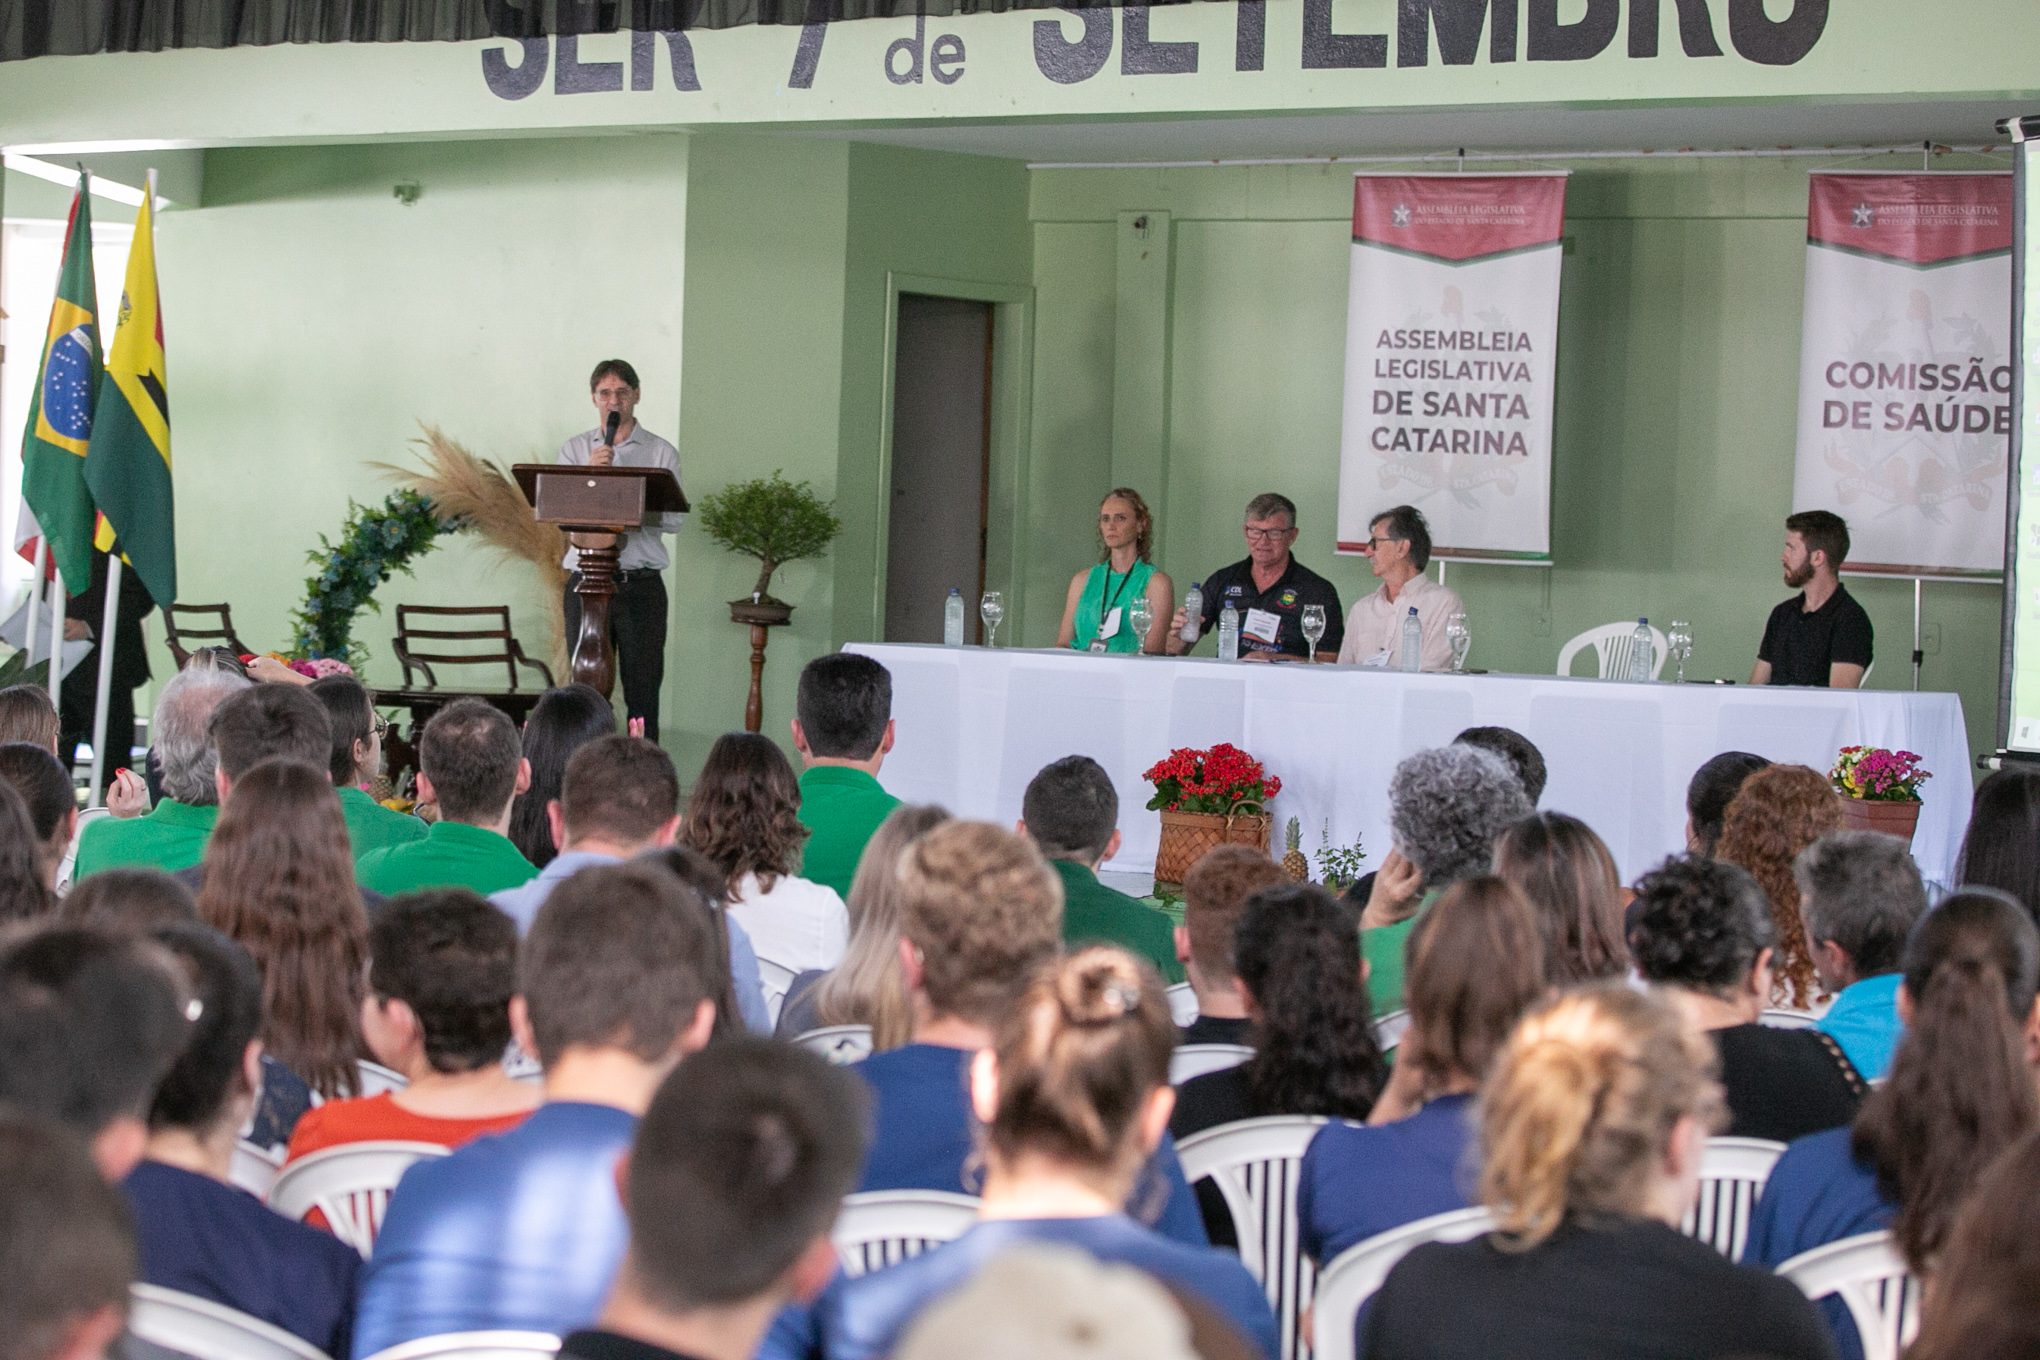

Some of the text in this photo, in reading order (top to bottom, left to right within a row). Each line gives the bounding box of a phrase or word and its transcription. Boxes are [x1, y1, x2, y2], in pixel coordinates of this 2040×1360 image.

[884, 8, 966, 85] de
[1938, 205, 1998, 216] LEGISLATIVA
[1376, 329, 1533, 352] ASSEMBLEIA
[1374, 358, 1532, 383] LEGISLATIVA
[1825, 357, 2011, 394] COMISSÃO
[1372, 390, 1530, 420] DE SANTA
[1822, 396, 2010, 435] DE SAÚDE
[1371, 426, 1528, 456] CATARINA
